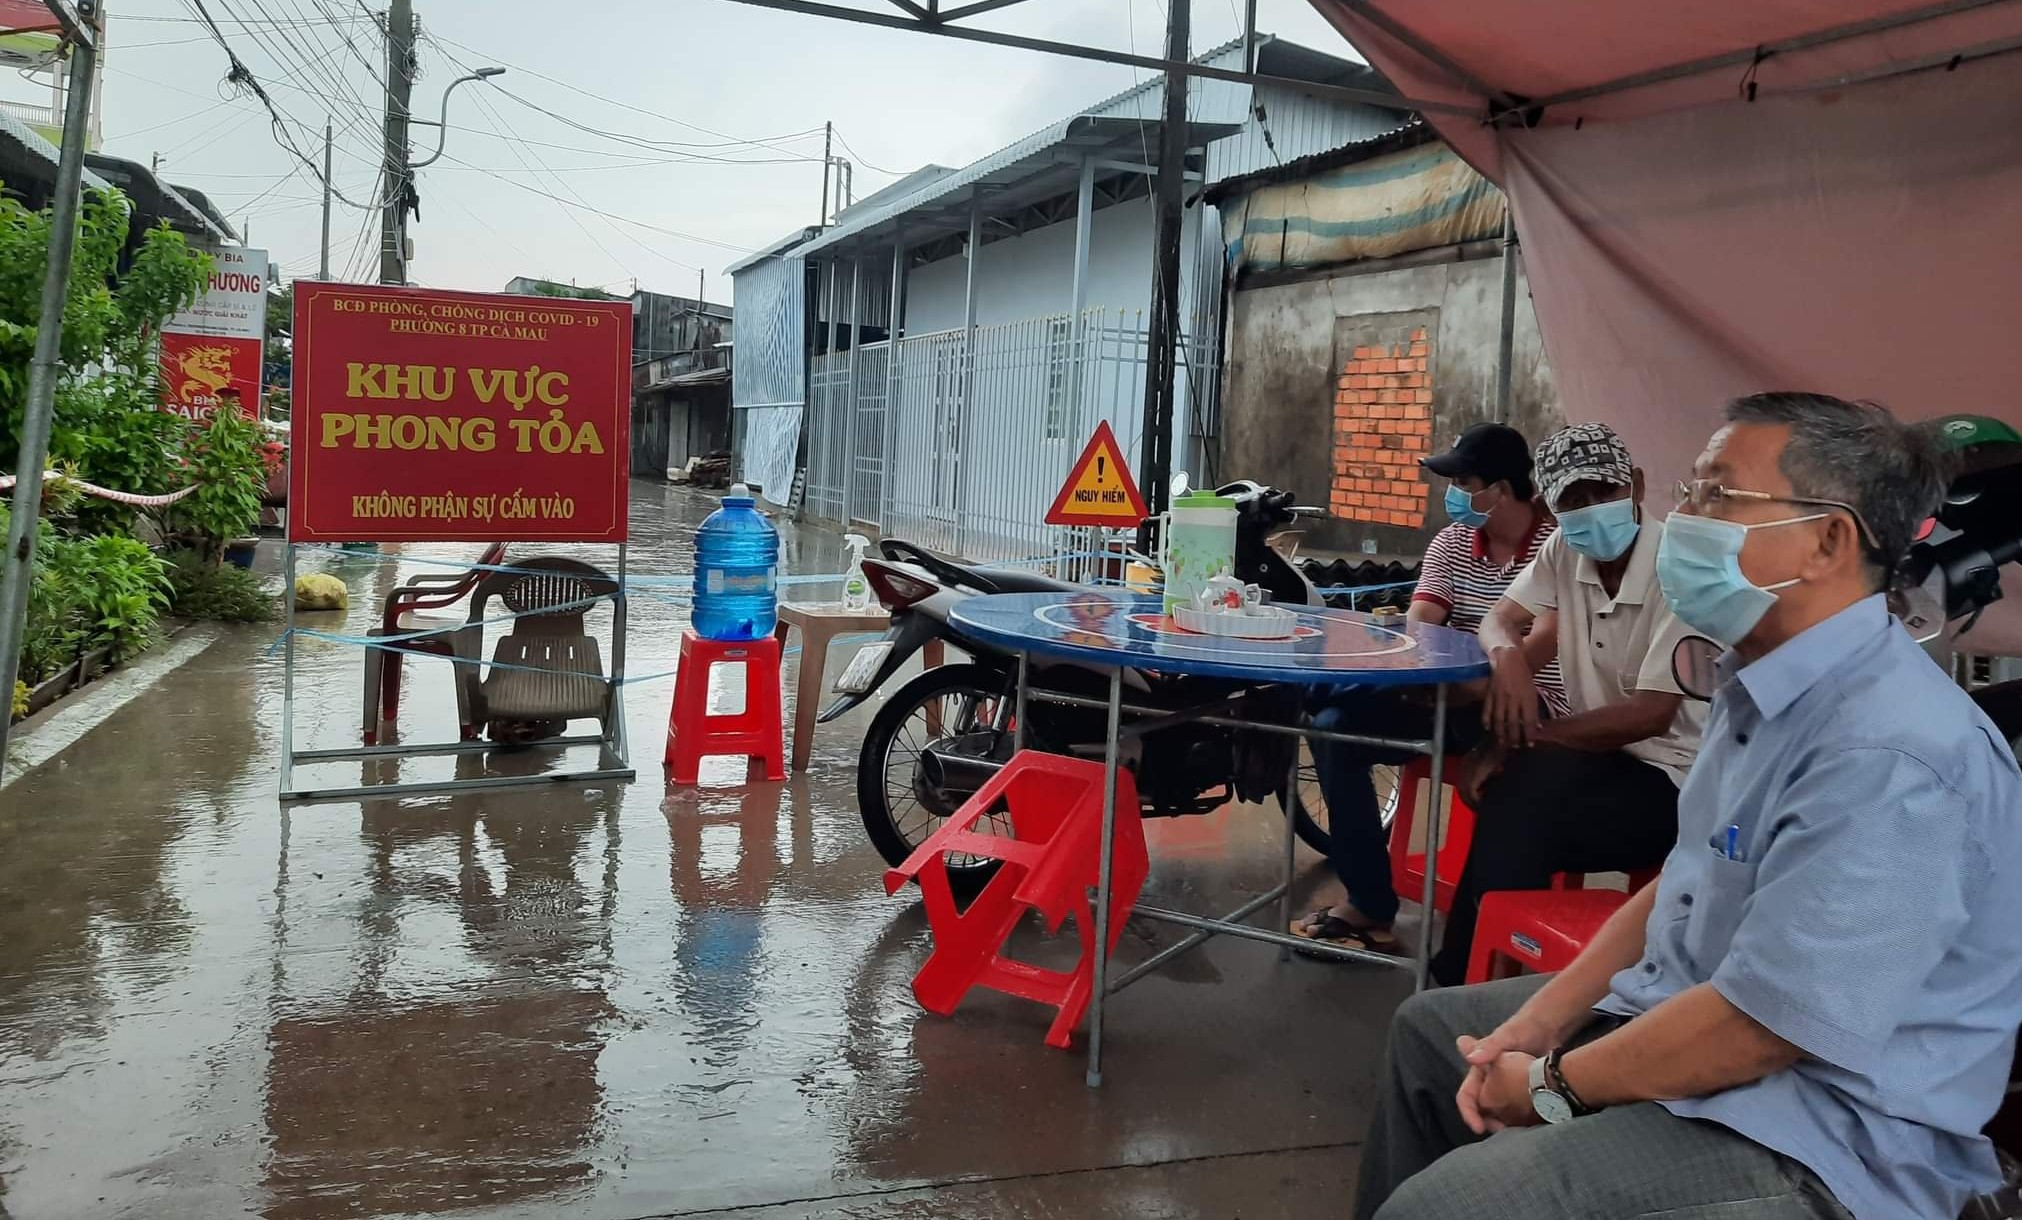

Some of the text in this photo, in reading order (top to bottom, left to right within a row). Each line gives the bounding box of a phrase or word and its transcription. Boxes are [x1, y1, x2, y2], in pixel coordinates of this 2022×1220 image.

[224, 252, 244, 262] BIA
[333, 299, 365, 312] BCĐ
[369, 299, 428, 318] PHÒNG,
[488, 309, 525, 324] DỊCH
[528, 311, 574, 326] COVID
[586, 315, 600, 327] 19
[390, 317, 456, 334] PHƯỜNG
[459, 323, 467, 334] 8
[514, 327, 548, 341] MAU
[346, 362, 569, 411] KHU VỰC
[320, 408, 605, 454] PHONG TỎA
[352, 487, 575, 523] KHÔNG PHẬN SỰ CẤM VÀO
[1075, 485, 1125, 503] NGUY HIỂM
